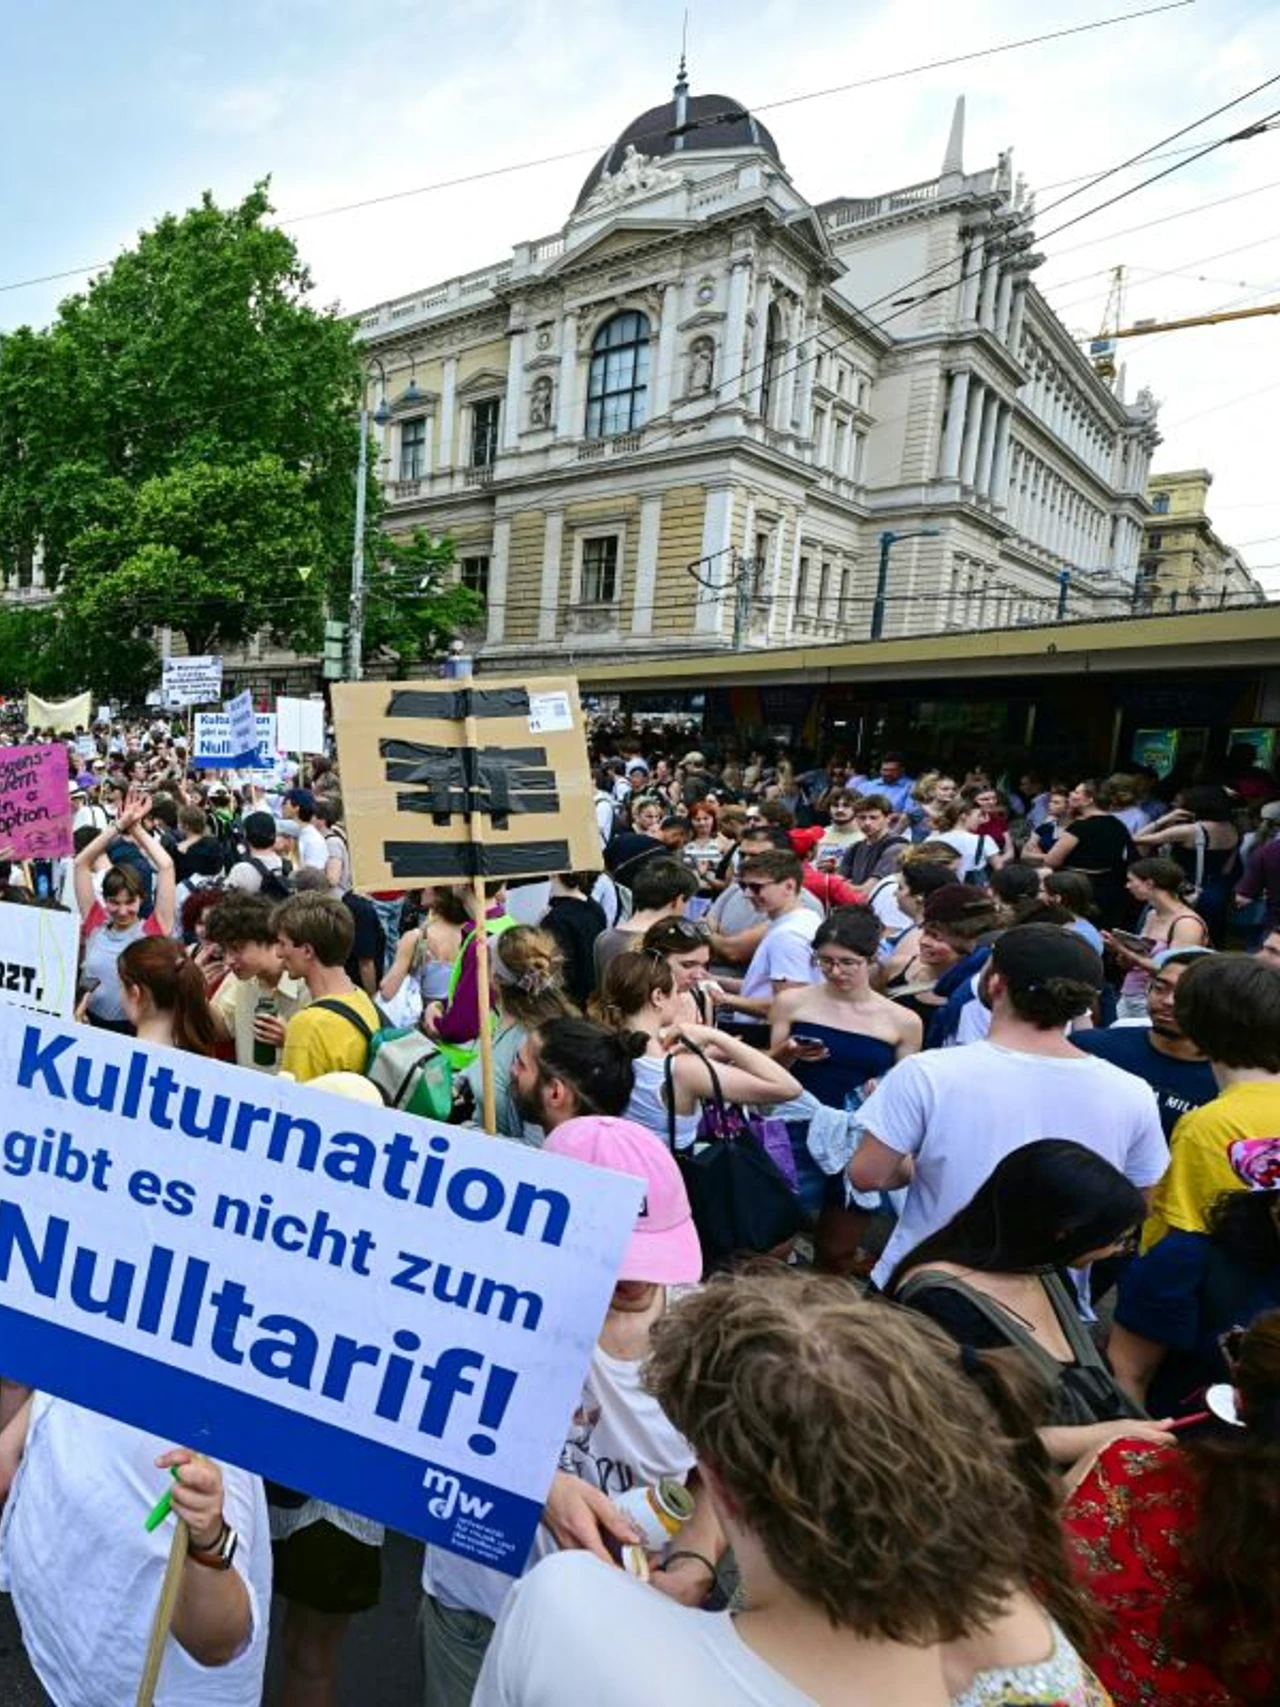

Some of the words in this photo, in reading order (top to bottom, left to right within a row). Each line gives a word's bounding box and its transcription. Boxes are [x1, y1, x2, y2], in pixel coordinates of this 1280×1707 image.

[3, 1127, 112, 1192] gibt
[128, 1169, 197, 1216] es
[213, 1194, 376, 1277] nicht
[390, 1250, 544, 1332] zum
[17, 1025, 570, 1247] Kulturnation
